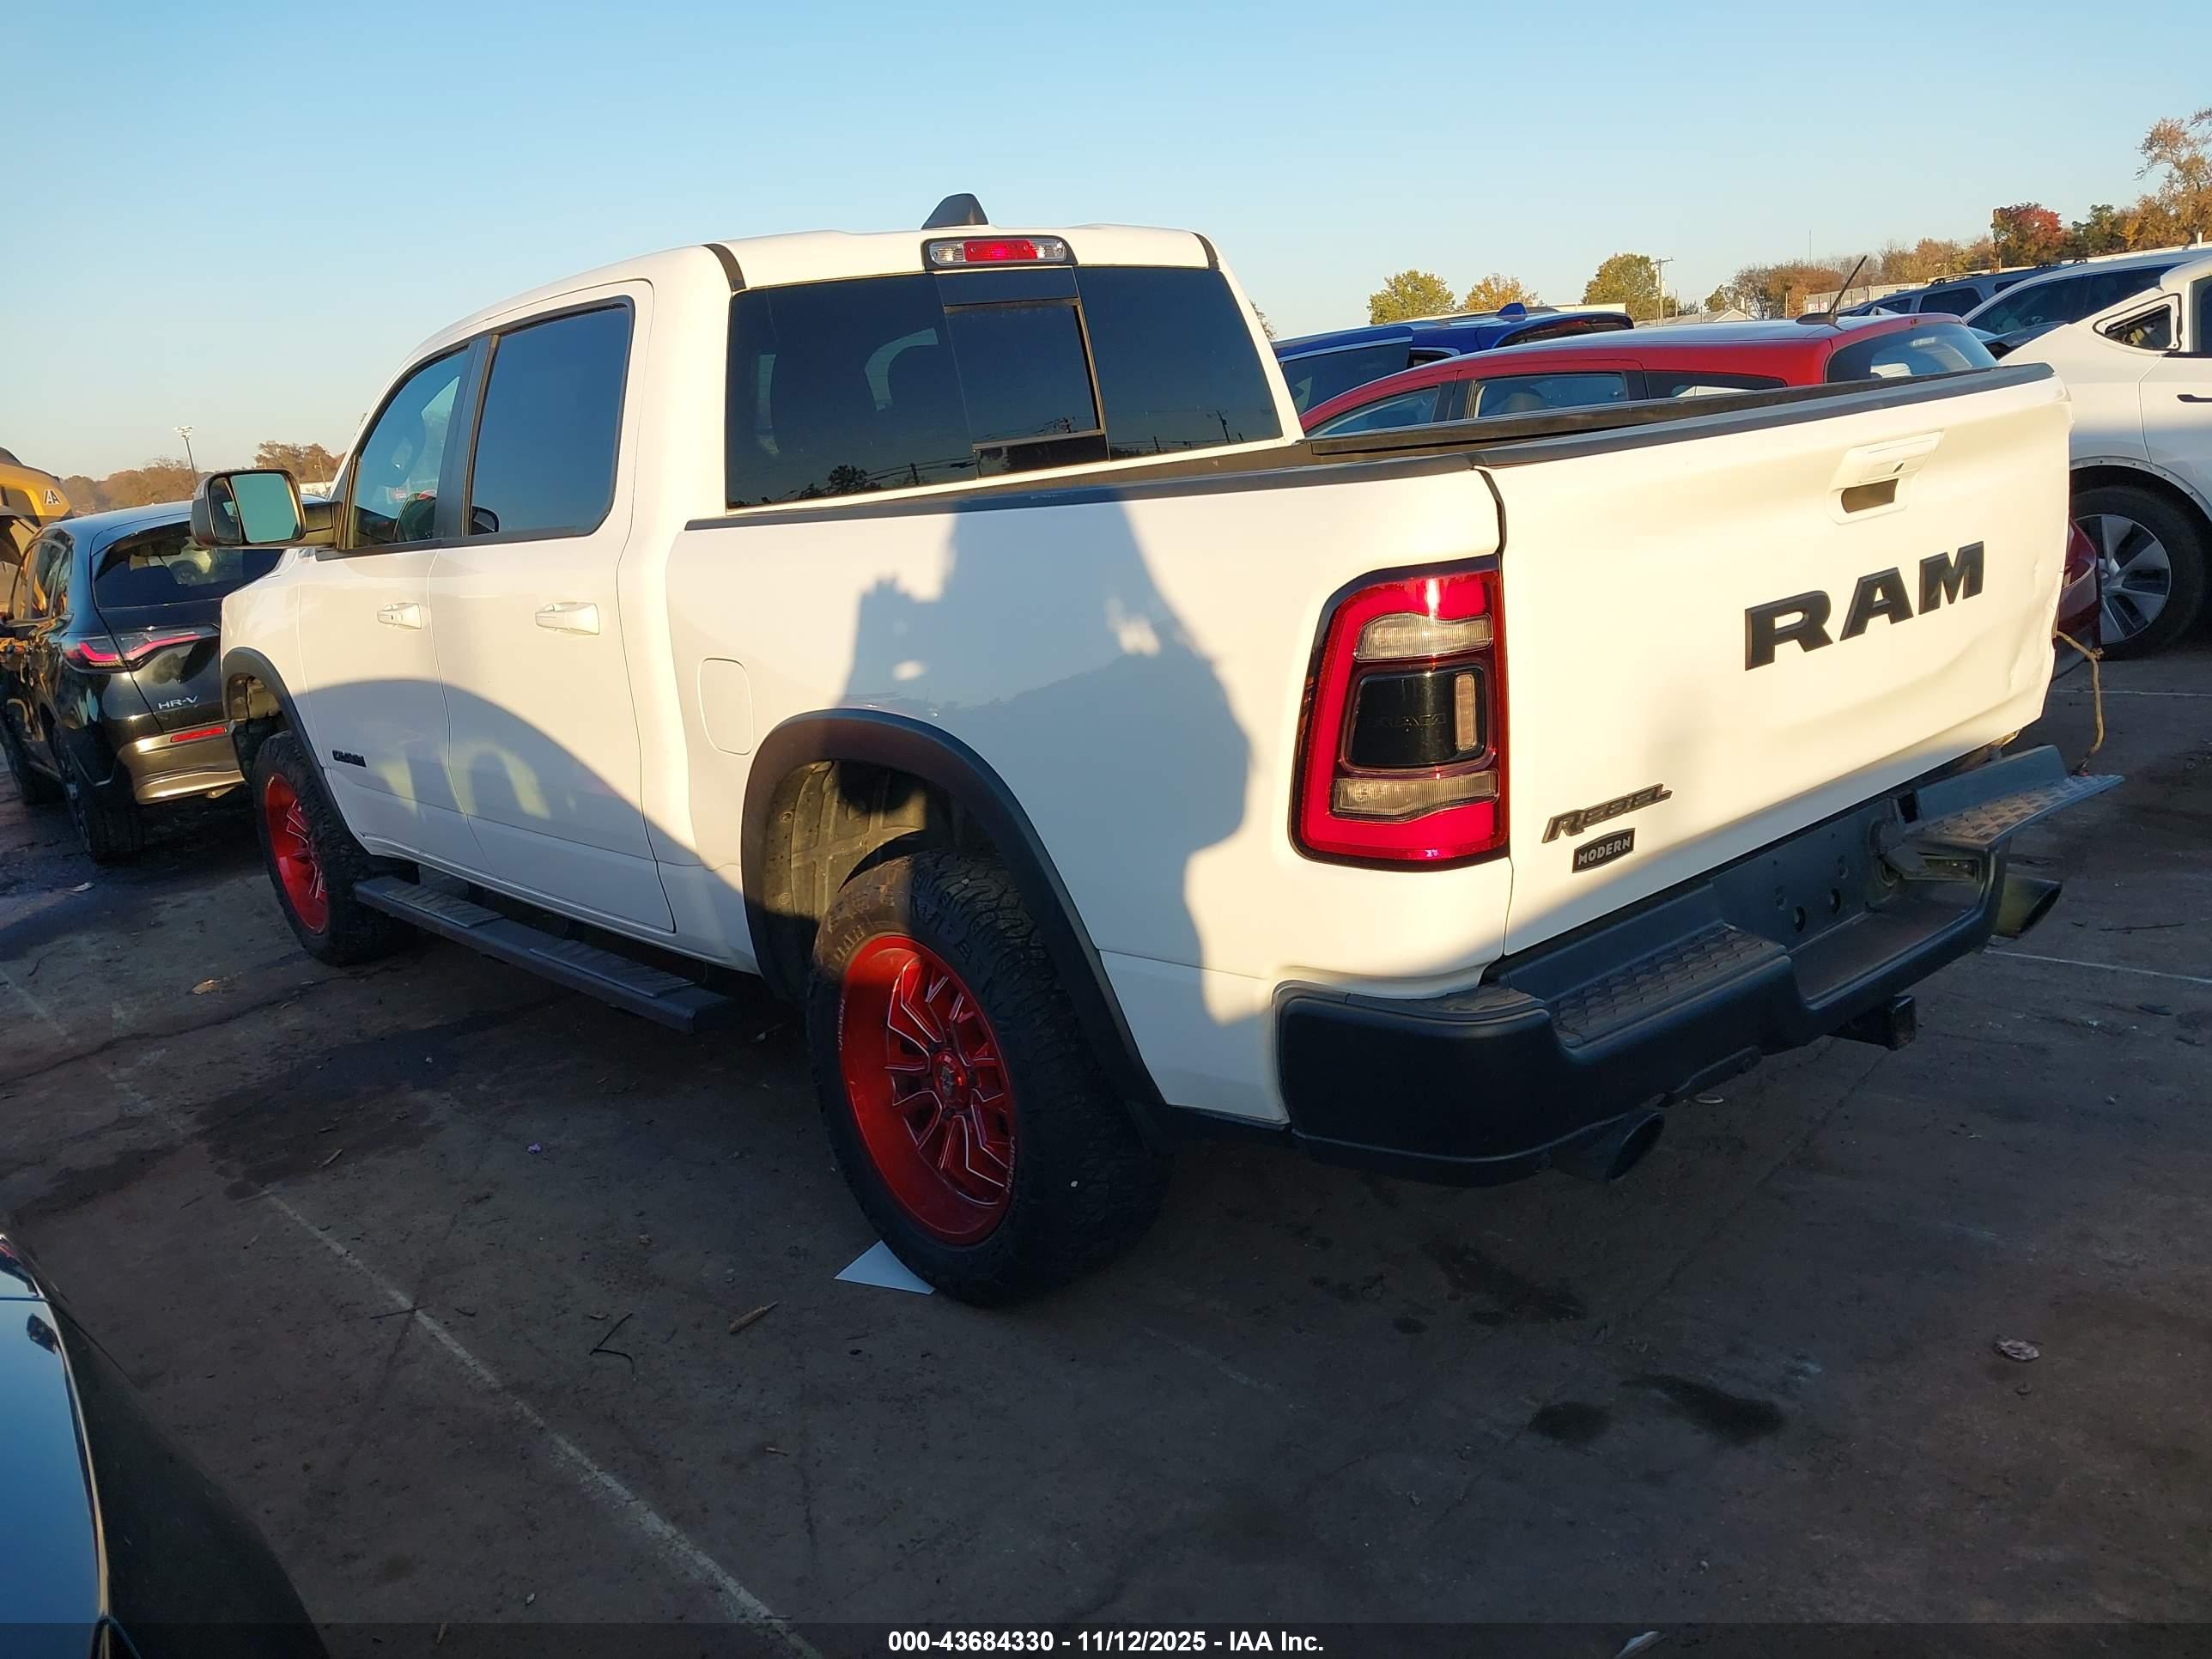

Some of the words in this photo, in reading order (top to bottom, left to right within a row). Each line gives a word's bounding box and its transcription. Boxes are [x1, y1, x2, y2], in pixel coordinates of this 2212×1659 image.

[1745, 541, 1984, 672] RAM
[158, 696, 198, 710] HR-V
[1577, 836, 1632, 866] MODERN
